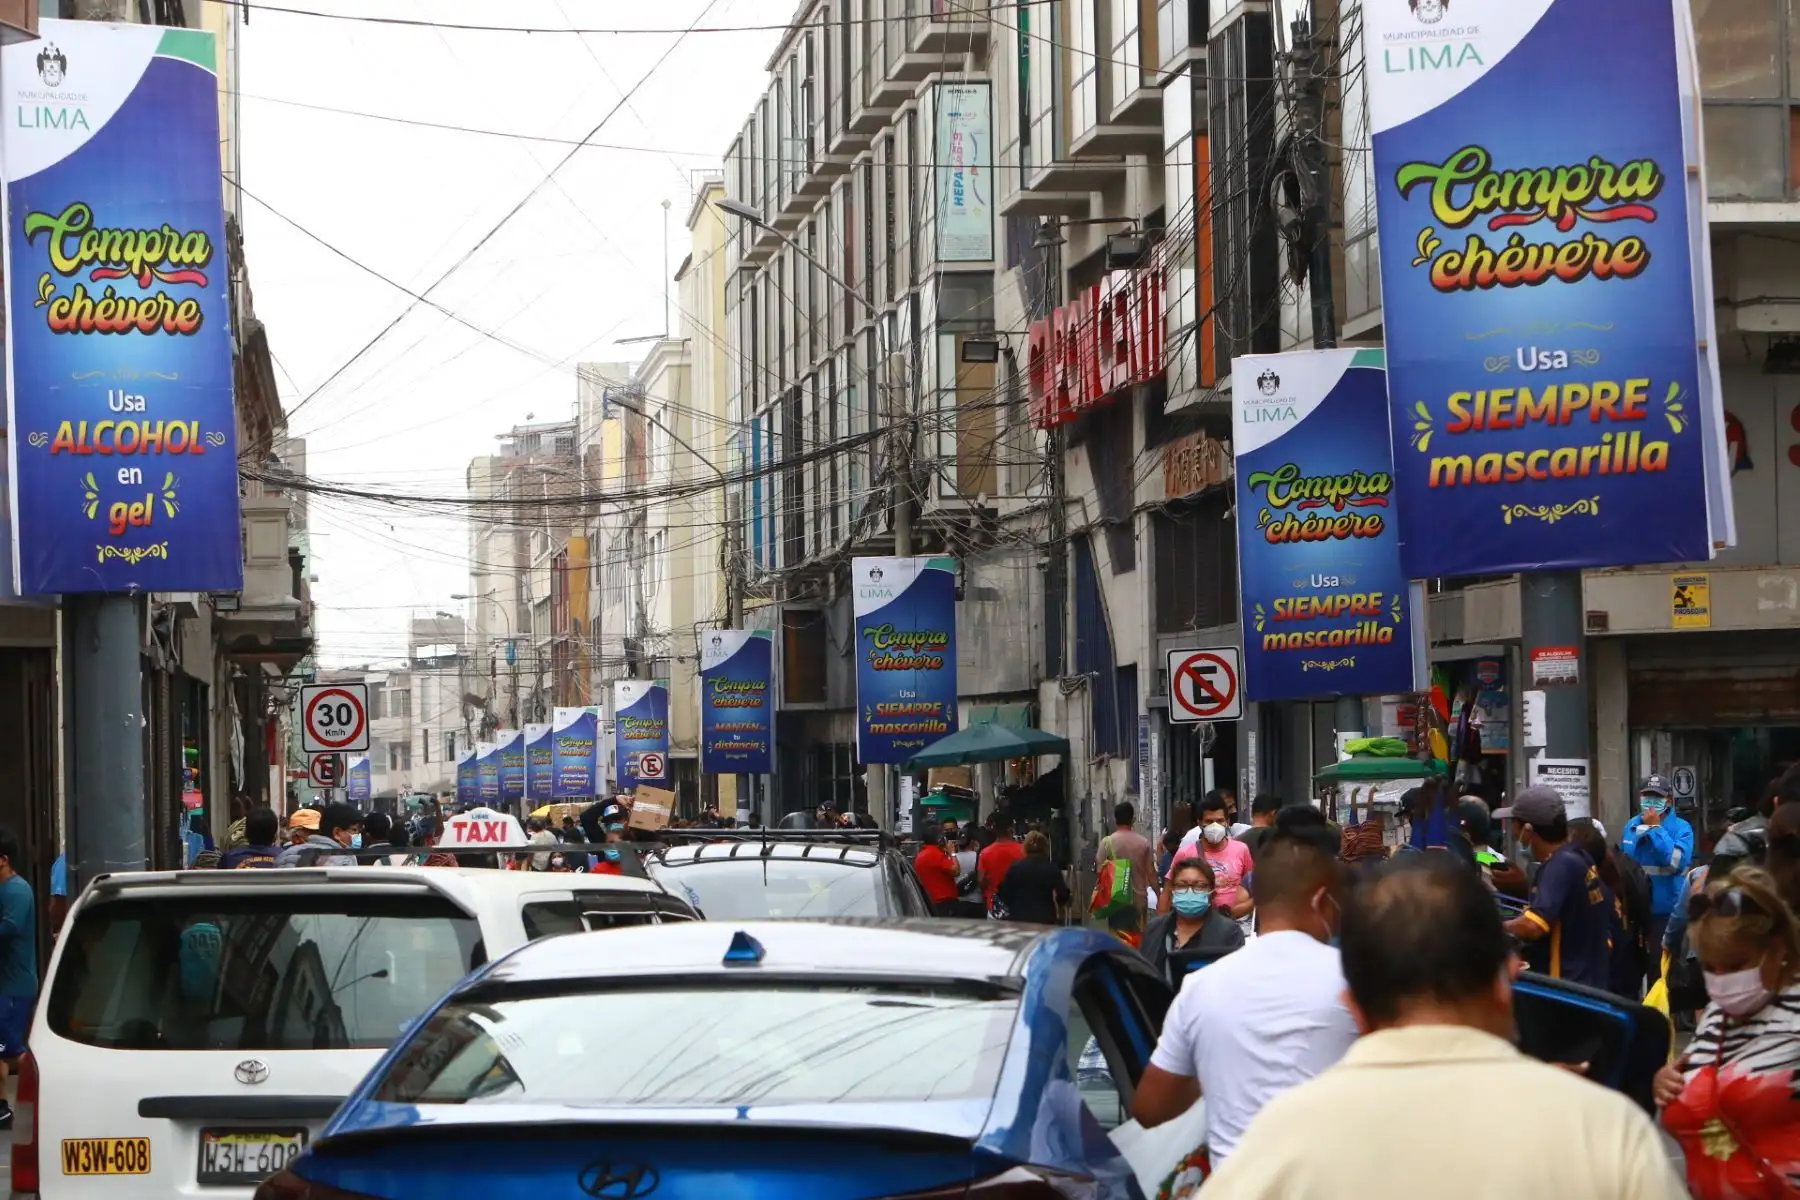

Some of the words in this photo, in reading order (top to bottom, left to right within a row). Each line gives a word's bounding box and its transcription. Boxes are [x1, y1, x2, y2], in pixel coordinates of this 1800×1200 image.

[1383, 27, 1464, 40] MUNICIPALIDAD
[1467, 25, 1480, 35] DE
[1384, 42, 1484, 74] LIMA
[18, 105, 90, 131] LIMA
[1395, 144, 1665, 228] Compra
[24, 201, 214, 277] Compra
[1428, 232, 1651, 293] chévere
[47, 283, 204, 335] chévere
[1517, 347, 1569, 372] Usa
[108, 389, 146, 412] Usa
[1445, 378, 1651, 434] SIEMPRE
[1243, 406, 1298, 424] LIMA
[50, 420, 206, 456] ALCOHOL
[1428, 430, 1670, 489] mascarilla
[117, 467, 143, 485] en
[1248, 462, 1394, 509] Compra
[108, 493, 154, 536] gel
[1264, 511, 1385, 544] chévere
[860, 587, 893, 599] LIMA
[1311, 573, 1340, 588] Usa
[1271, 592, 1383, 622] SIEMPRE
[863, 623, 949, 651] Compra
[1262, 620, 1393, 652] mascarilla
[872, 650, 944, 671] chévere
[708, 676, 766, 693] Compra
[899, 689, 916, 699] Usa
[1192, 666, 1221, 705] E
[317, 702, 353, 727] 30
[876, 702, 942, 717] SIEMPRE
[869, 719, 949, 734] mascarilla
[714, 740, 760, 751] distancia
[452, 821, 508, 842] TAXI
[63, 1139, 147, 1173] W3W-608
